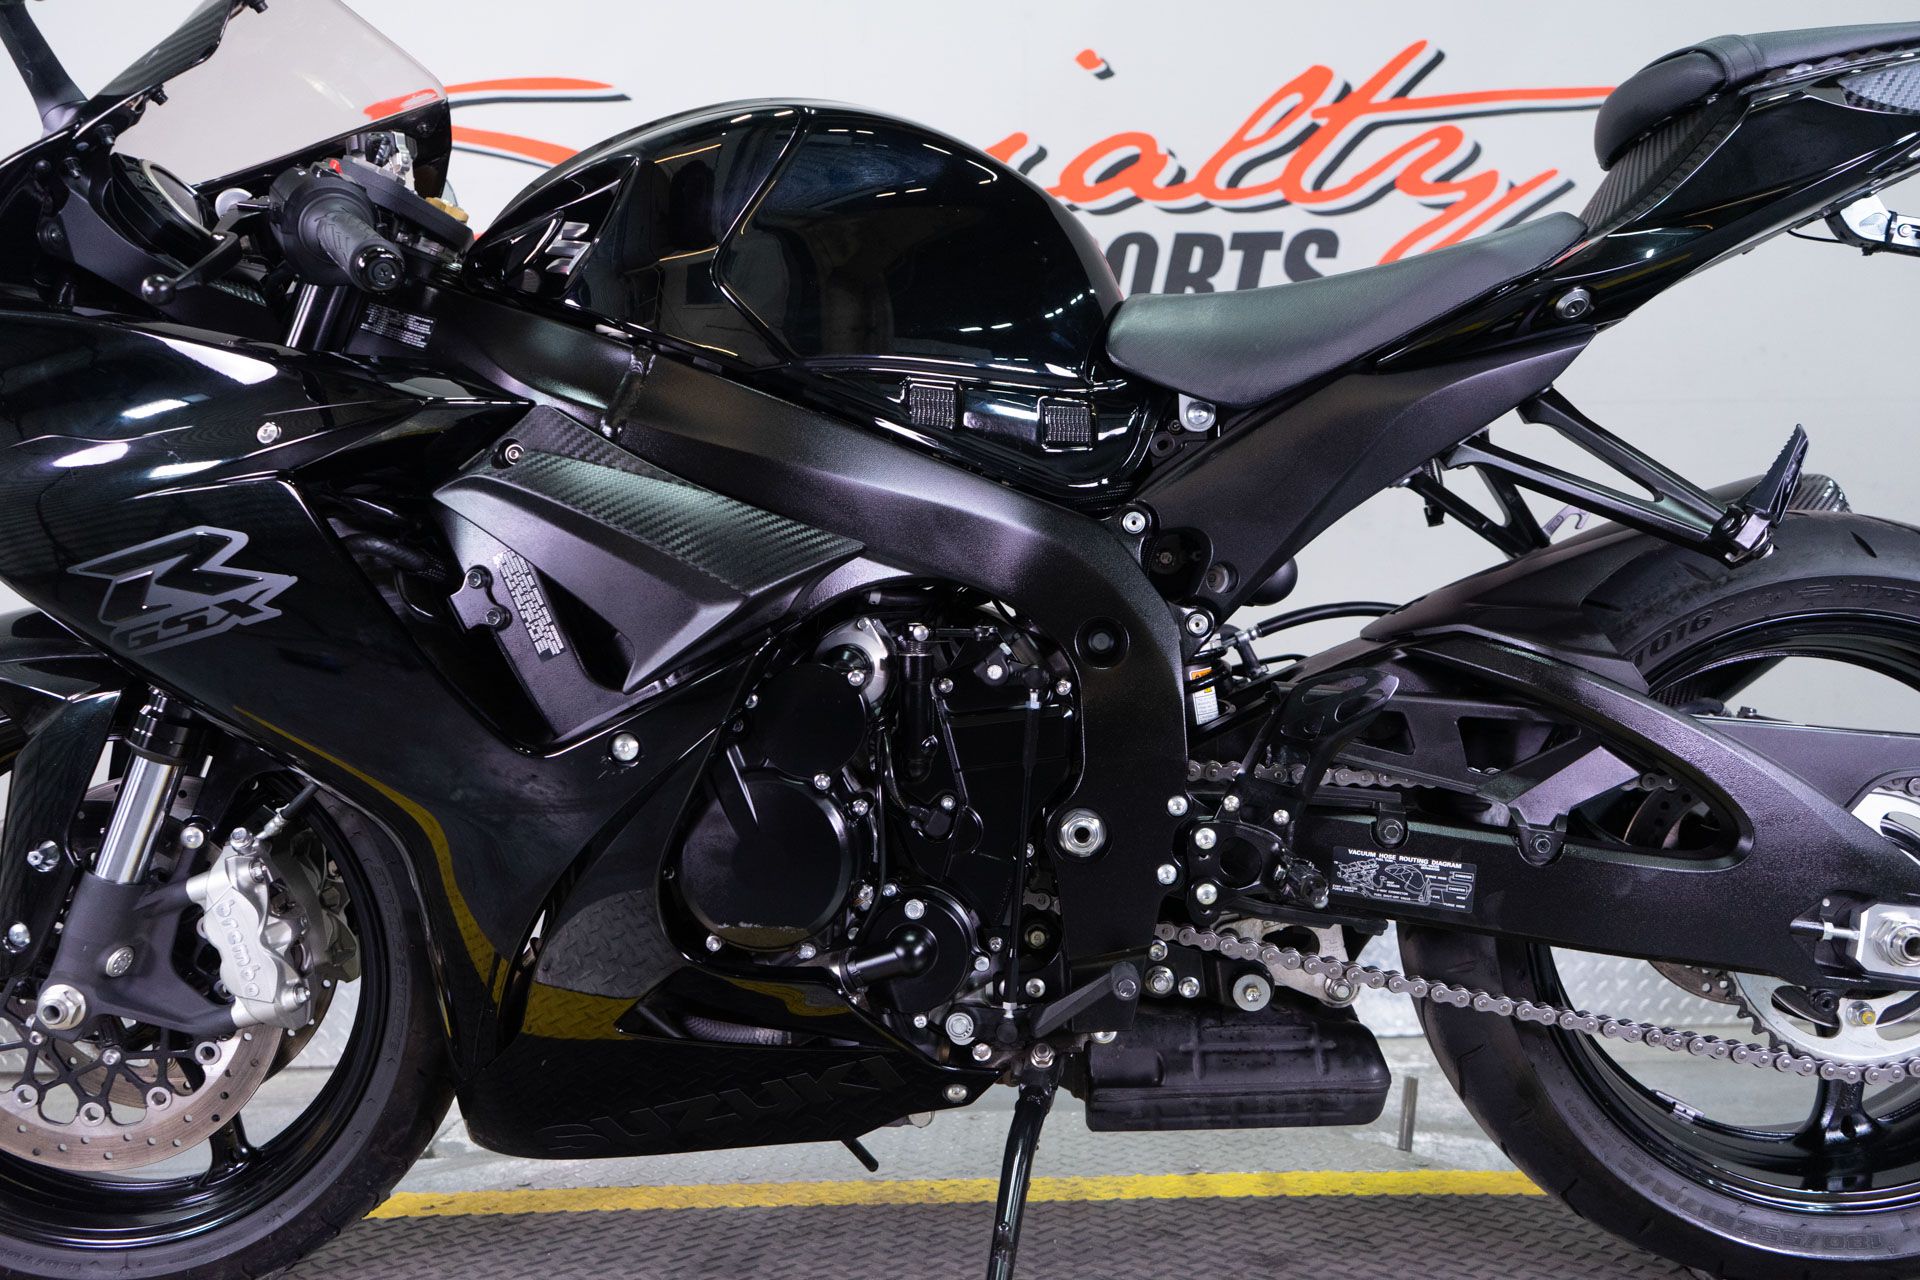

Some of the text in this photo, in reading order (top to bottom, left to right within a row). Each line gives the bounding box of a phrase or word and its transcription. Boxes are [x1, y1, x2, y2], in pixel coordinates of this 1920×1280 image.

[1347, 848, 1377, 858] VACUUM
[1378, 852, 1397, 860] HOSE
[1398, 855, 1429, 865] ROUTING
[1431, 859, 1462, 869] DIAGRAM
[215, 898, 261, 998] brembo
